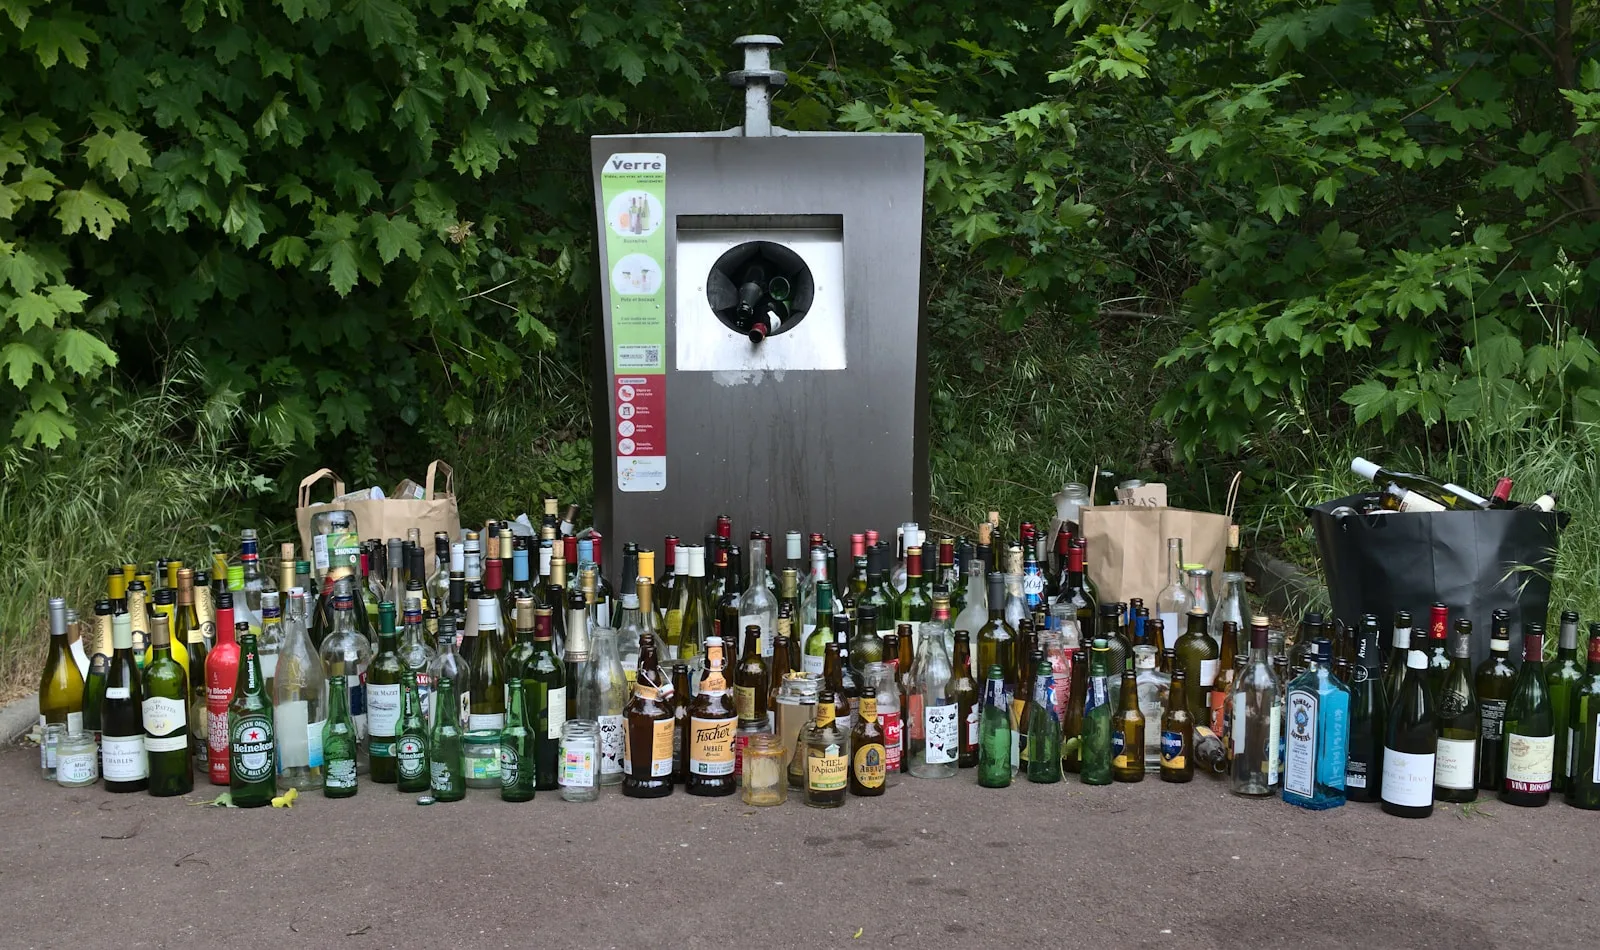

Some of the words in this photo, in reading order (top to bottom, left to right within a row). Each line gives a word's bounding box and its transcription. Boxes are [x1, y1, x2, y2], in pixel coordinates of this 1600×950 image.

[612, 160, 662, 170] Verre
[202, 588, 210, 617] LANSON
[134, 598, 142, 628] LANSON
[96, 618, 104, 649] LANSON
[247, 661, 255, 689] Heineken
[1293, 698, 1312, 711] BOMBAY
[235, 722, 254, 740] HEINEKEN
[696, 723, 731, 744] Fischer
[233, 743, 273, 754] Heineken
[860, 764, 884, 773] ABBAYE
[1511, 780, 1527, 791] VIÑA
